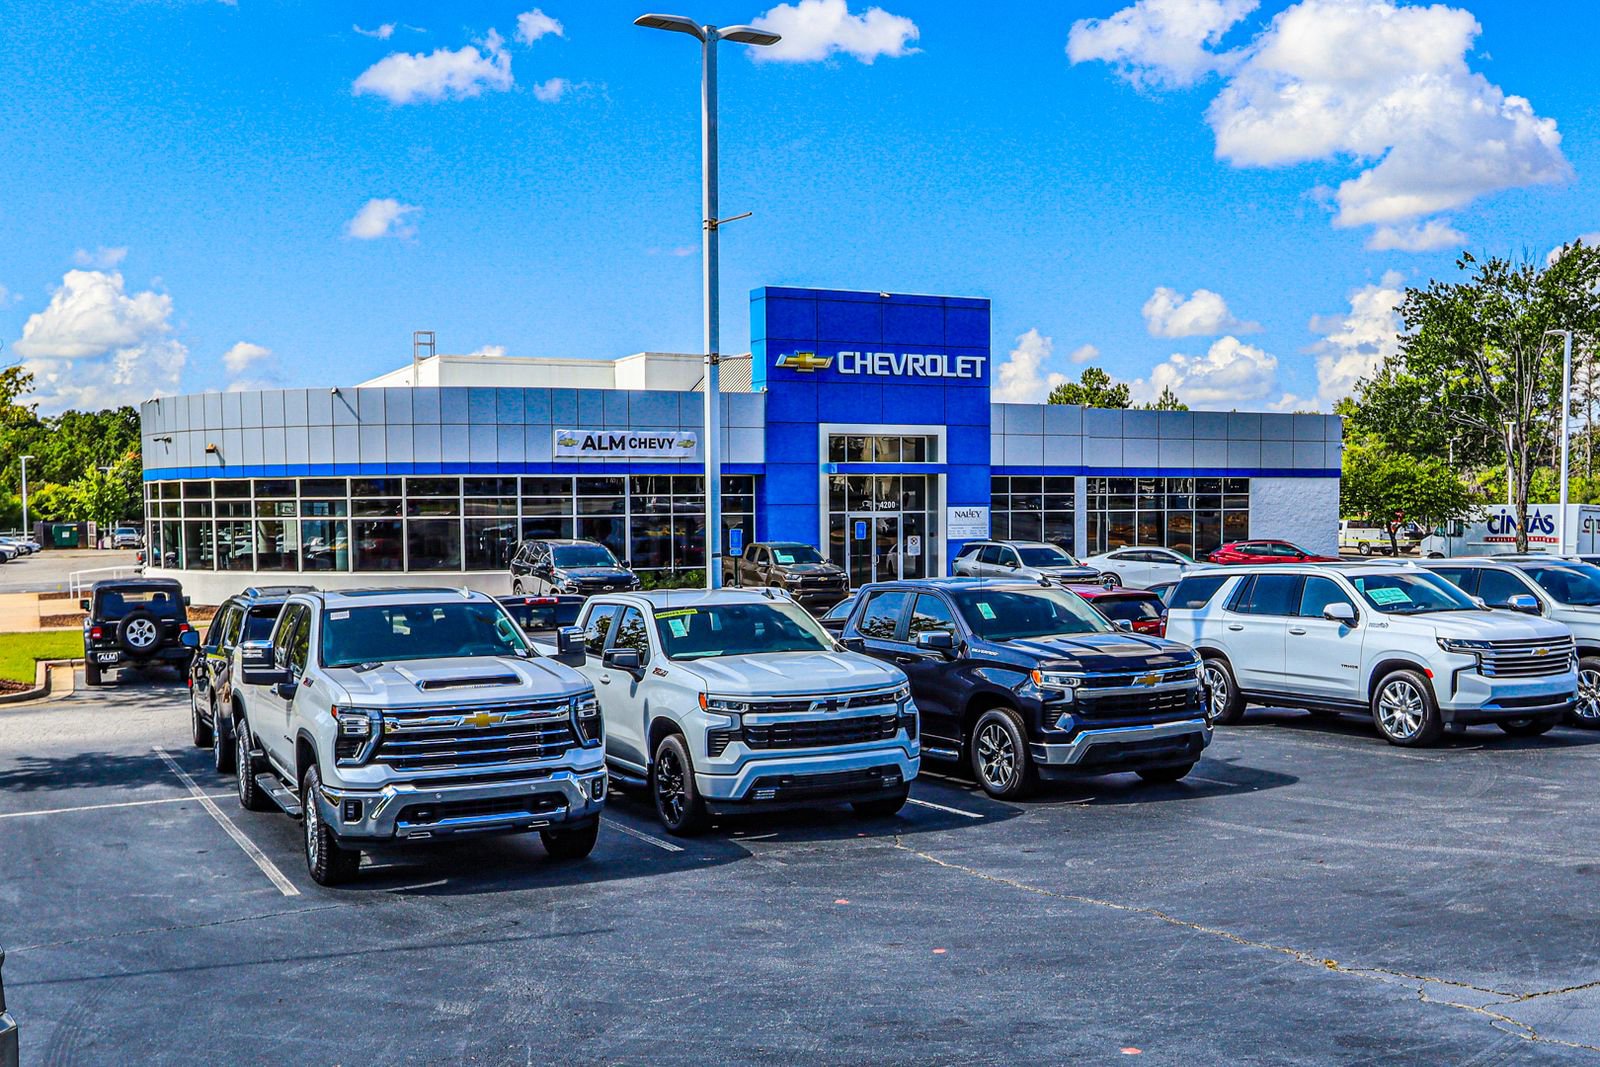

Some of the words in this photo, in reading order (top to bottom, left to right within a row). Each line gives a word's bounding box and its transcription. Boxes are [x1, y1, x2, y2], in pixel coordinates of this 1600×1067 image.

[837, 351, 986, 378] CHEVROLET
[581, 435, 625, 451] ALM
[628, 437, 674, 449] CHEVY
[880, 501, 896, 509] 4200
